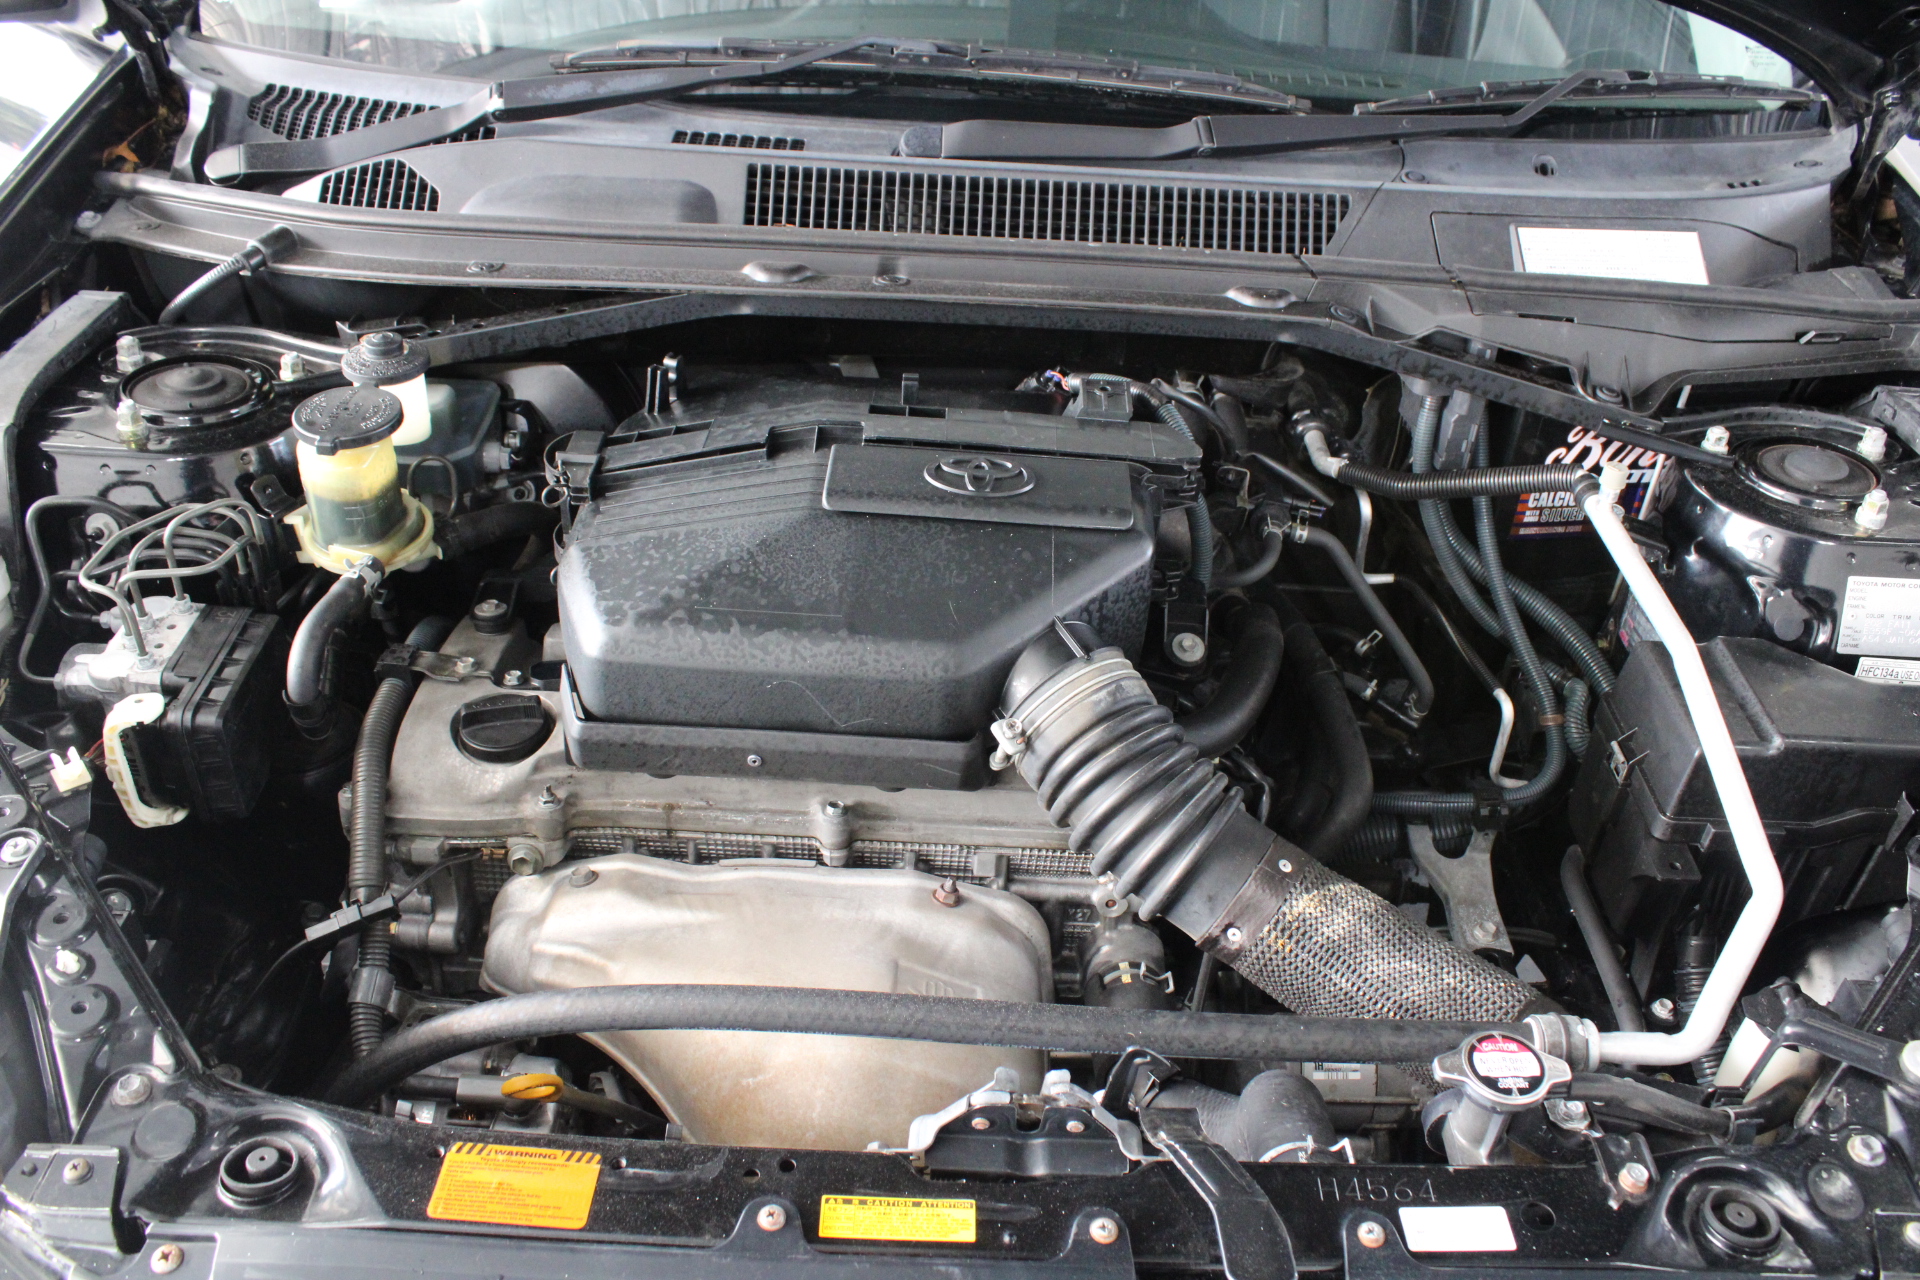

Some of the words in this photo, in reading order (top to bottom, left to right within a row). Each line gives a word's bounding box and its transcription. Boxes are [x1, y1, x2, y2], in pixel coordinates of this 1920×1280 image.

[1861, 666, 1899, 678] HFC134a
[1900, 670, 1914, 680] USE
[1482, 1042, 1519, 1052] CAUTION
[1498, 1081, 1530, 1089] COOLANT
[494, 1149, 558, 1160] WARNING
[1317, 1177, 1437, 1202] H4564
[867, 1199, 913, 1207] CAUTION
